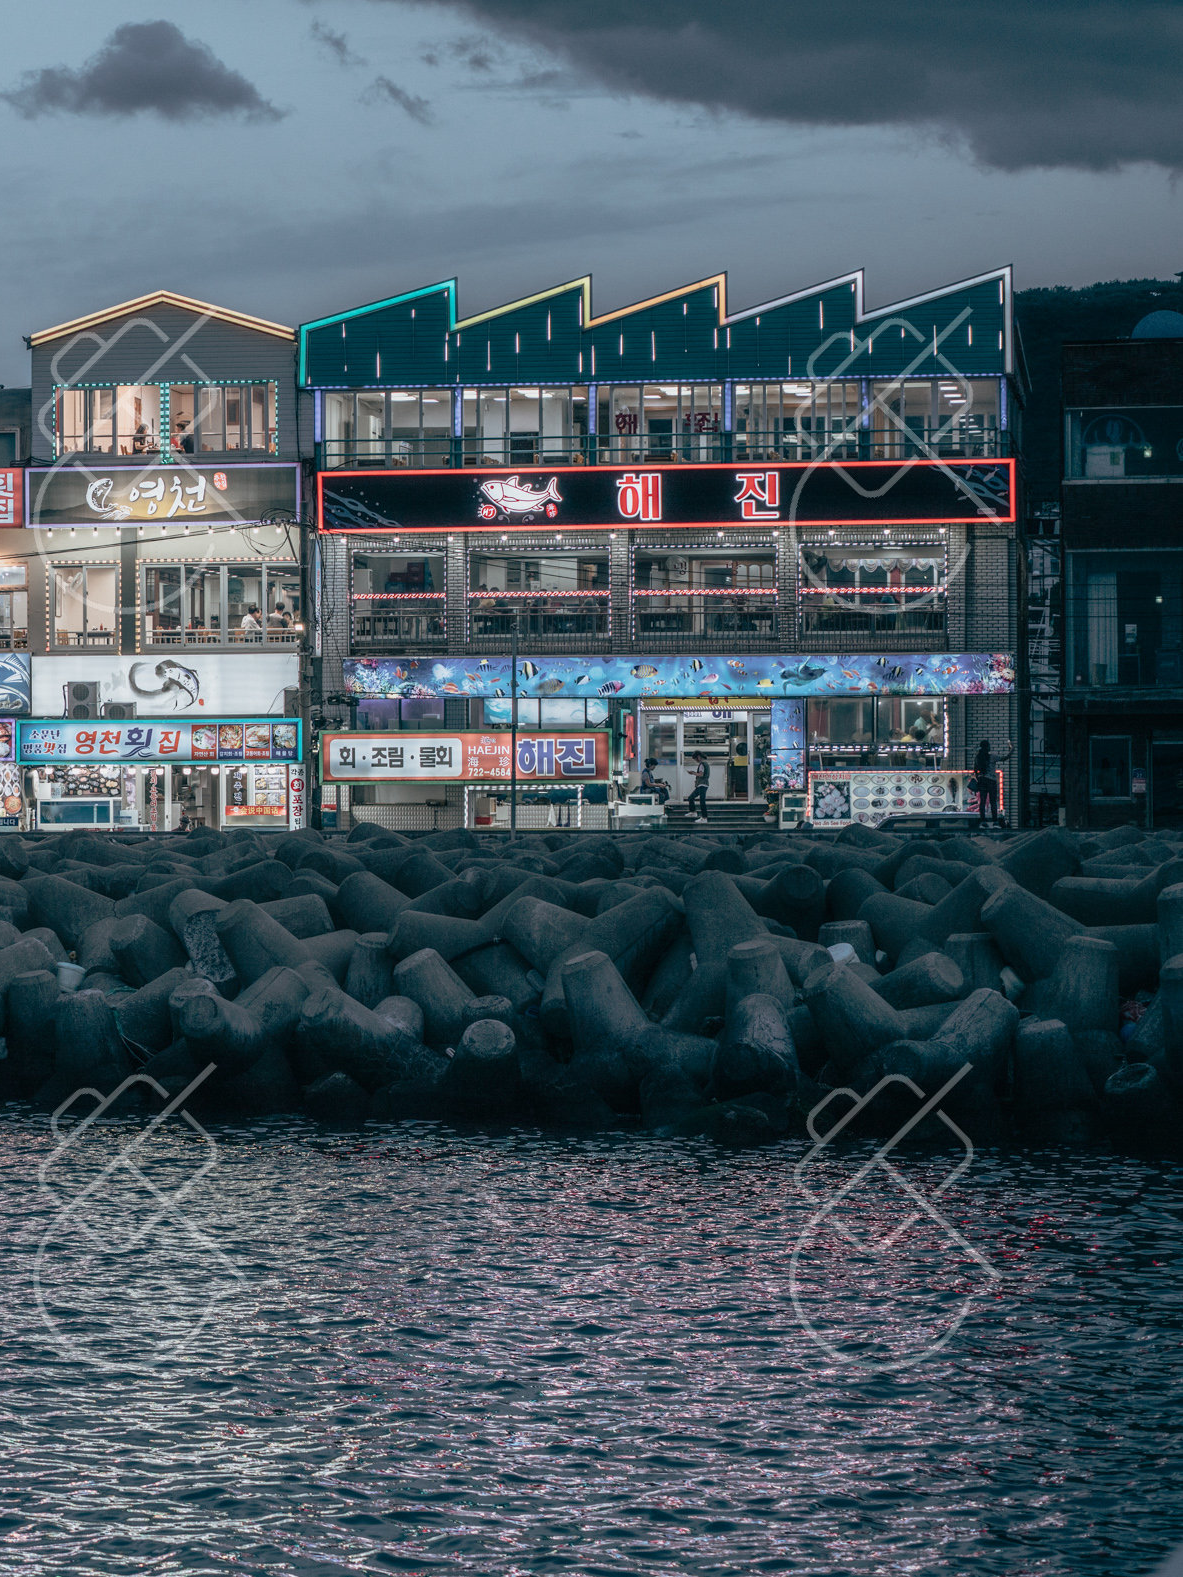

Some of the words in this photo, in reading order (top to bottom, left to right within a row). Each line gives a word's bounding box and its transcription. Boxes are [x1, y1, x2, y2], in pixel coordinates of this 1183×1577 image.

[130, 475, 206, 518] 영천
[616, 471, 780, 521] 해진
[31, 729, 60, 740] 소문난
[339, 747, 355, 768] 회
[371, 747, 403, 768] 조림
[419, 746, 452, 768] 물회
[468, 746, 510, 755] HAEJIN
[517, 739, 596, 776] 해진
[468, 757, 510, 767] 海珍
[468, 768, 511, 776] 722-4584
